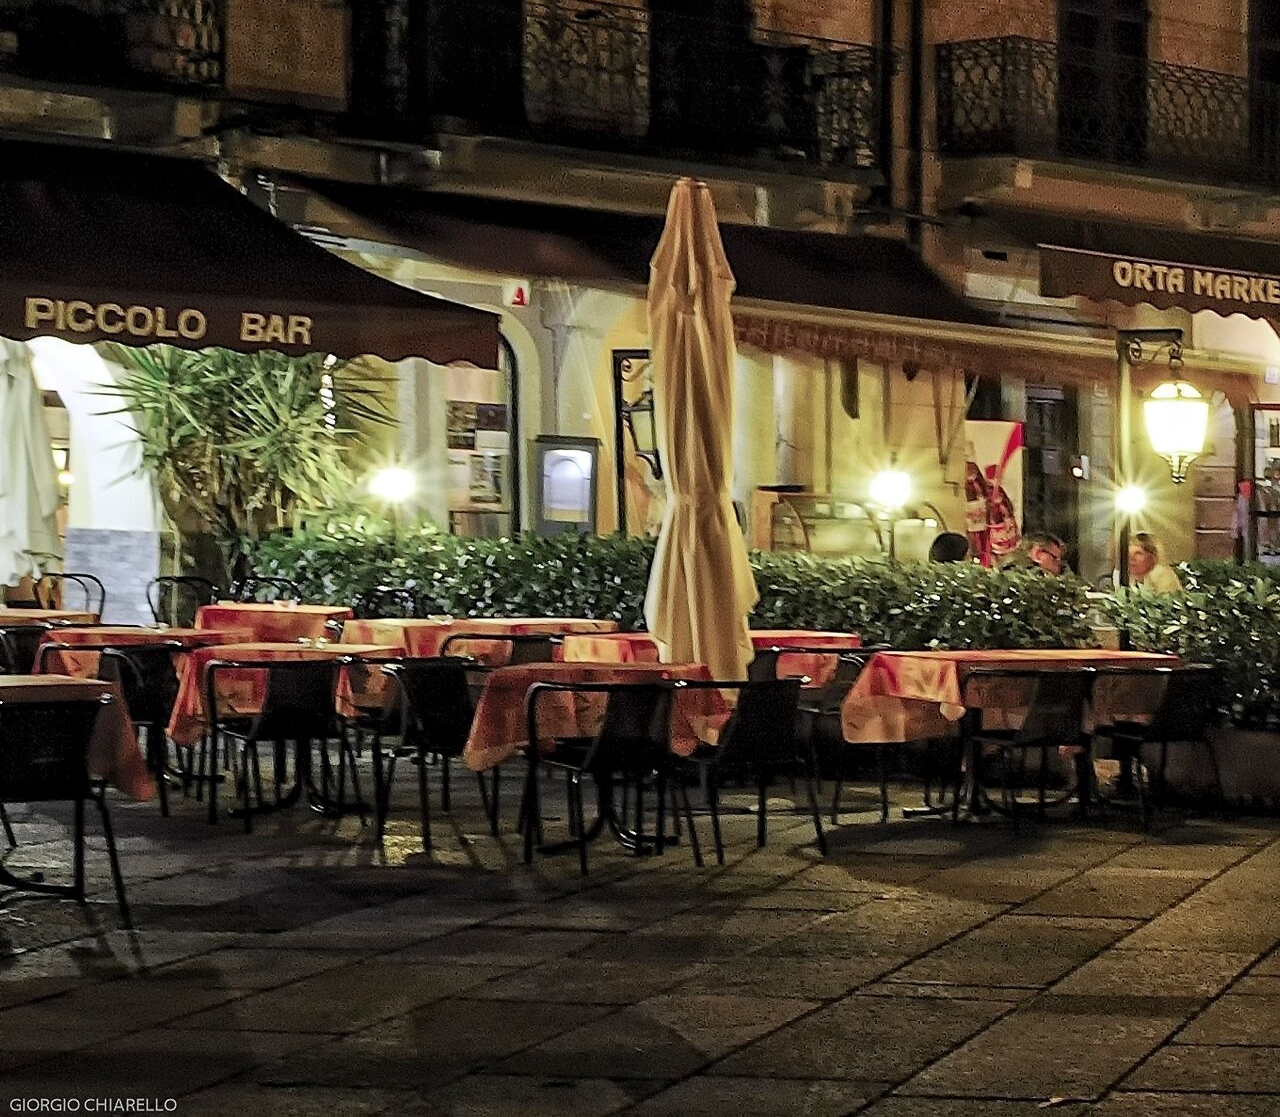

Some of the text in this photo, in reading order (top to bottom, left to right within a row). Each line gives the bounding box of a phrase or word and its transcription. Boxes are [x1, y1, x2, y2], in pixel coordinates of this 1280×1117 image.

[1113, 261, 1185, 294] ORTA
[24, 296, 312, 345] PICCOLO BAR
